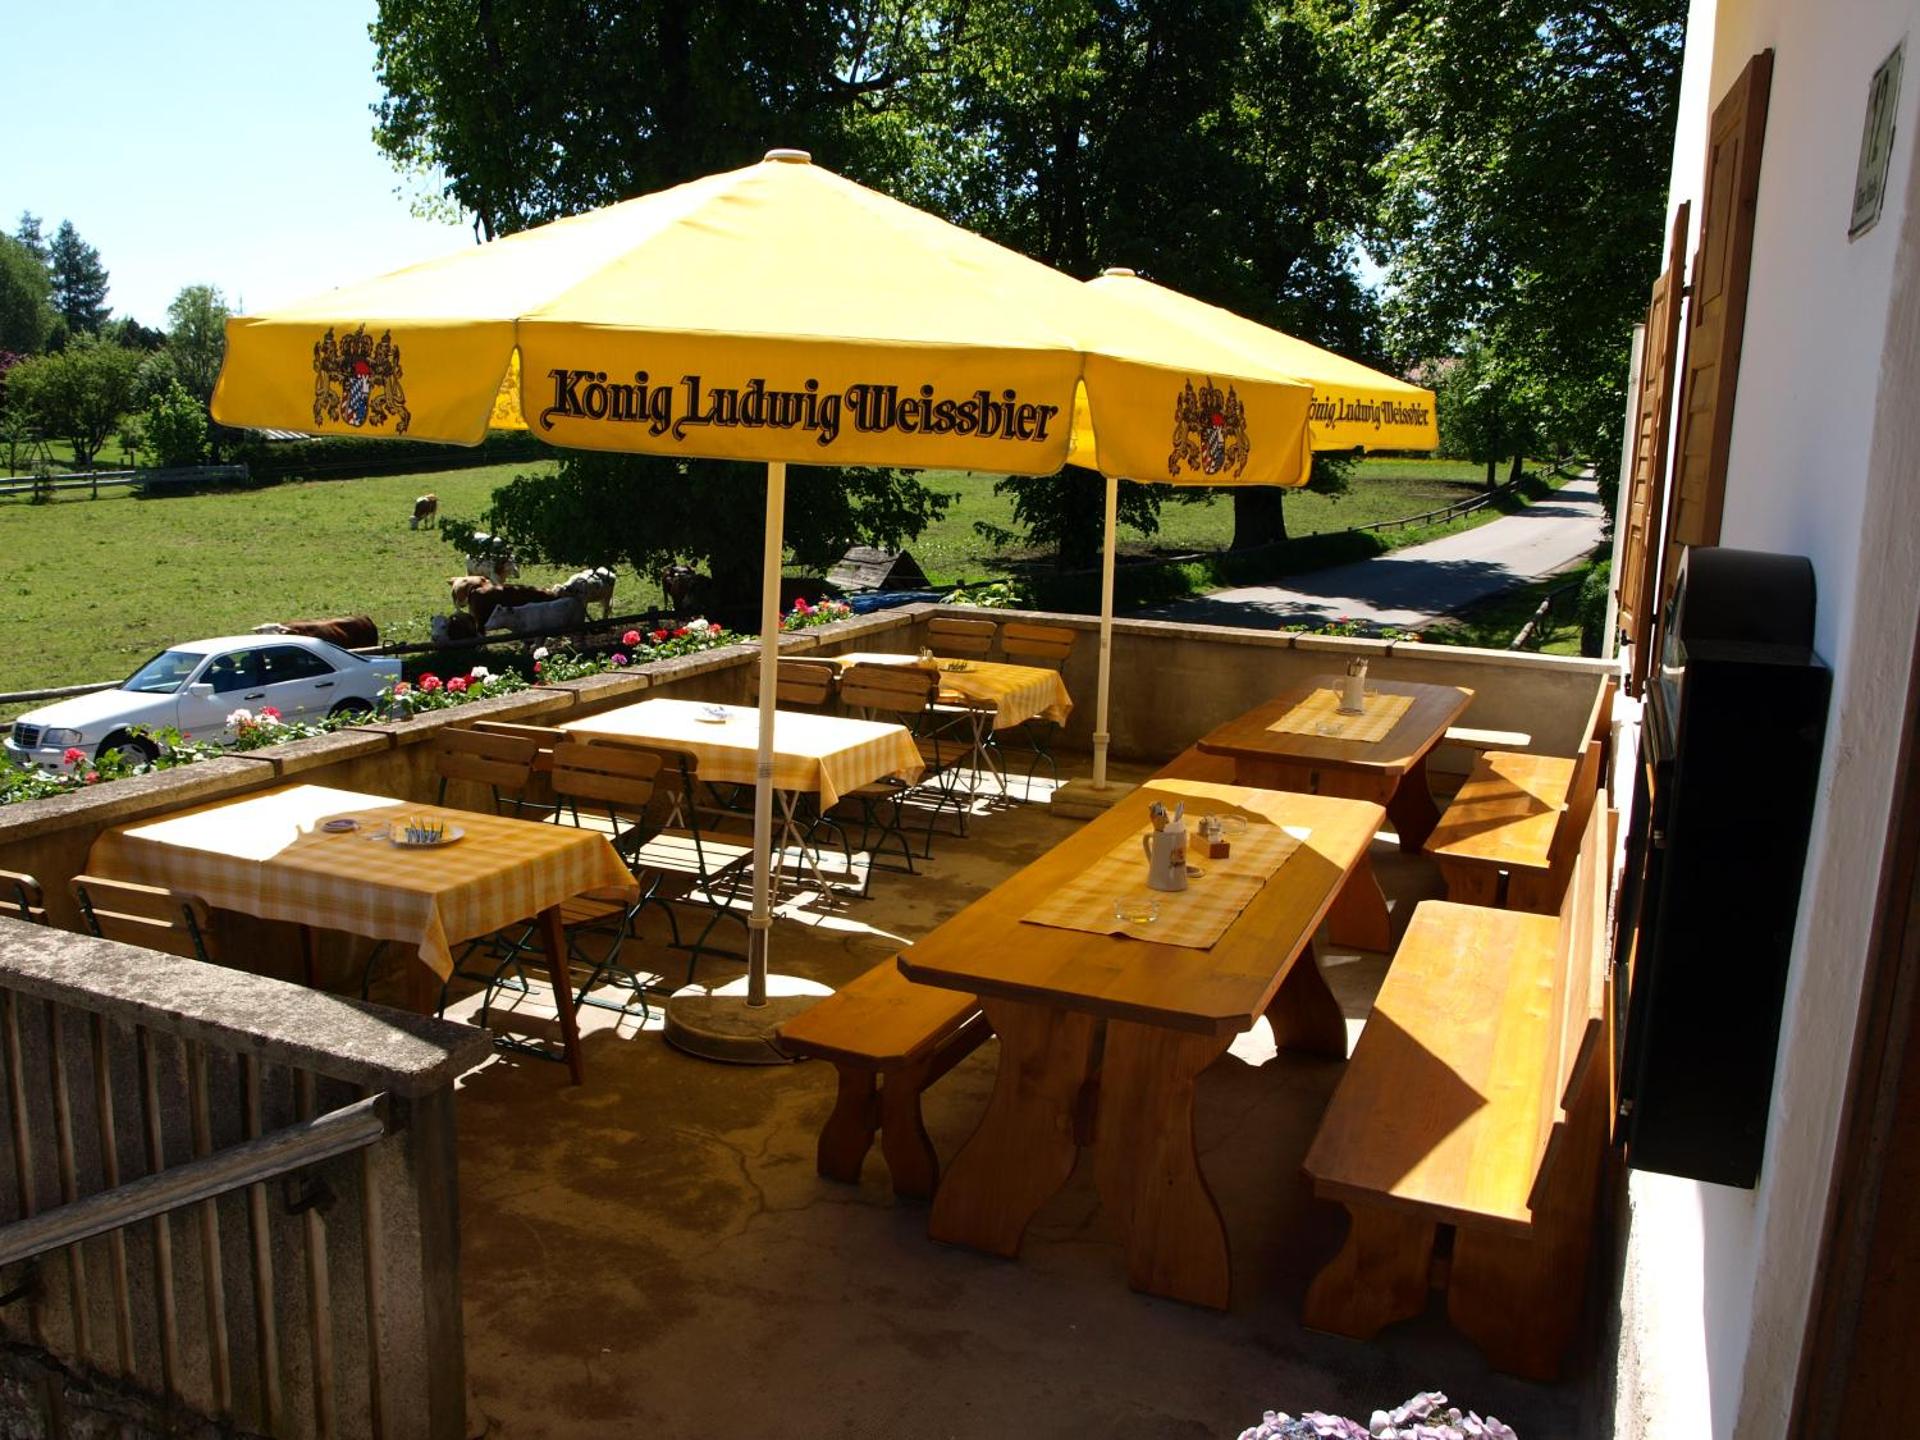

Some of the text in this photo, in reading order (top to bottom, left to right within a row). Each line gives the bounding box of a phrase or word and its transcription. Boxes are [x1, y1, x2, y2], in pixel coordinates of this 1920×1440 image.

[540, 369, 1058, 446] König Ludwig Weissbier
[1309, 396, 1429, 431] önig Ludwig Weissbier
